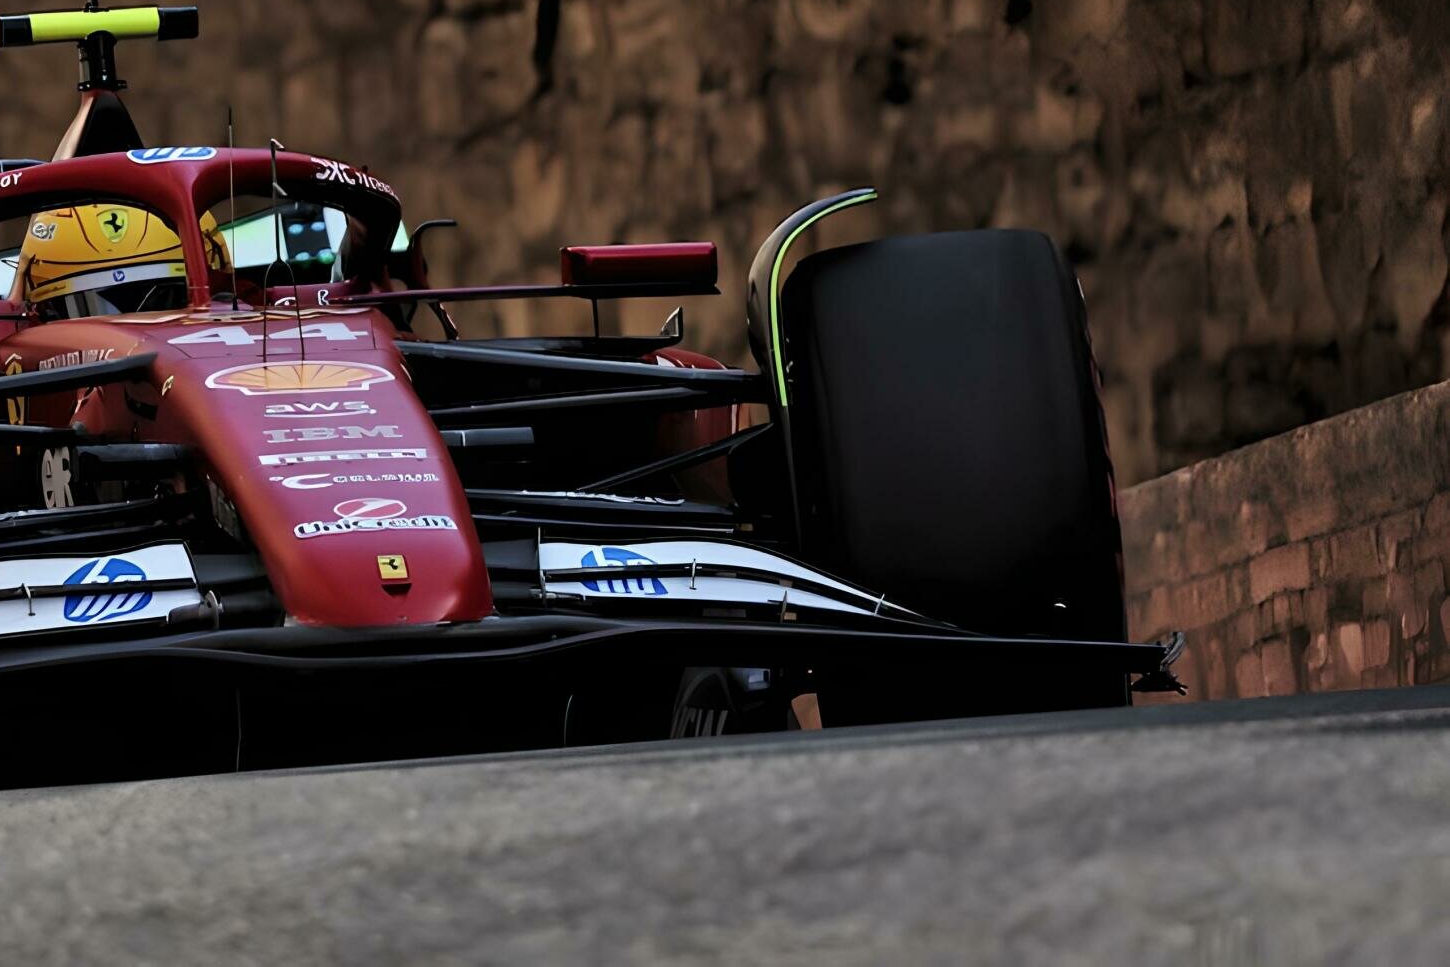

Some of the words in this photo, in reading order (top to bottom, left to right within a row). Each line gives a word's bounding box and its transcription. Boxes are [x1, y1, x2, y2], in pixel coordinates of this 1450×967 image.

[167, 323, 368, 345] 44
[265, 401, 370, 414] aws
[262, 425, 403, 443] IBM
